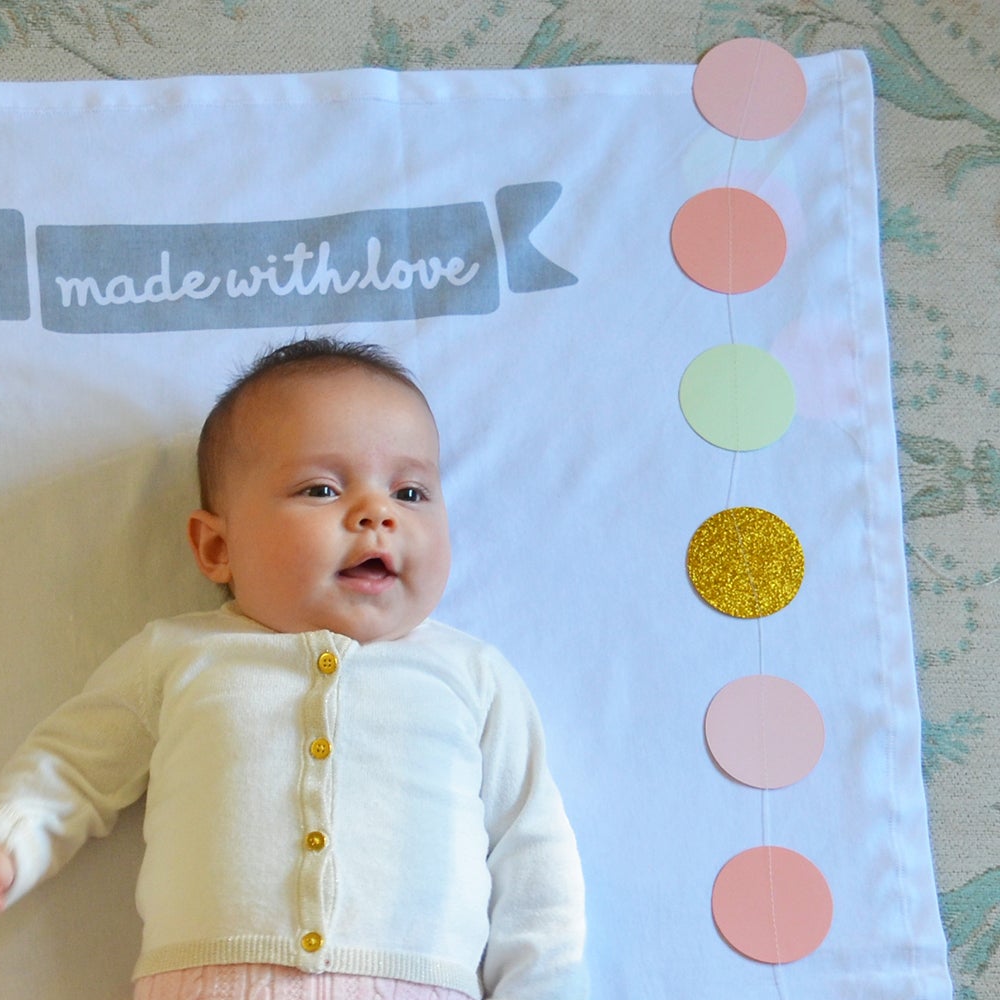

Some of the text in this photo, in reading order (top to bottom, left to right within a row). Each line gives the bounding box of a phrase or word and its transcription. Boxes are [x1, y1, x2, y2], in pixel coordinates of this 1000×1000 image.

[55, 236, 480, 307] made with love
